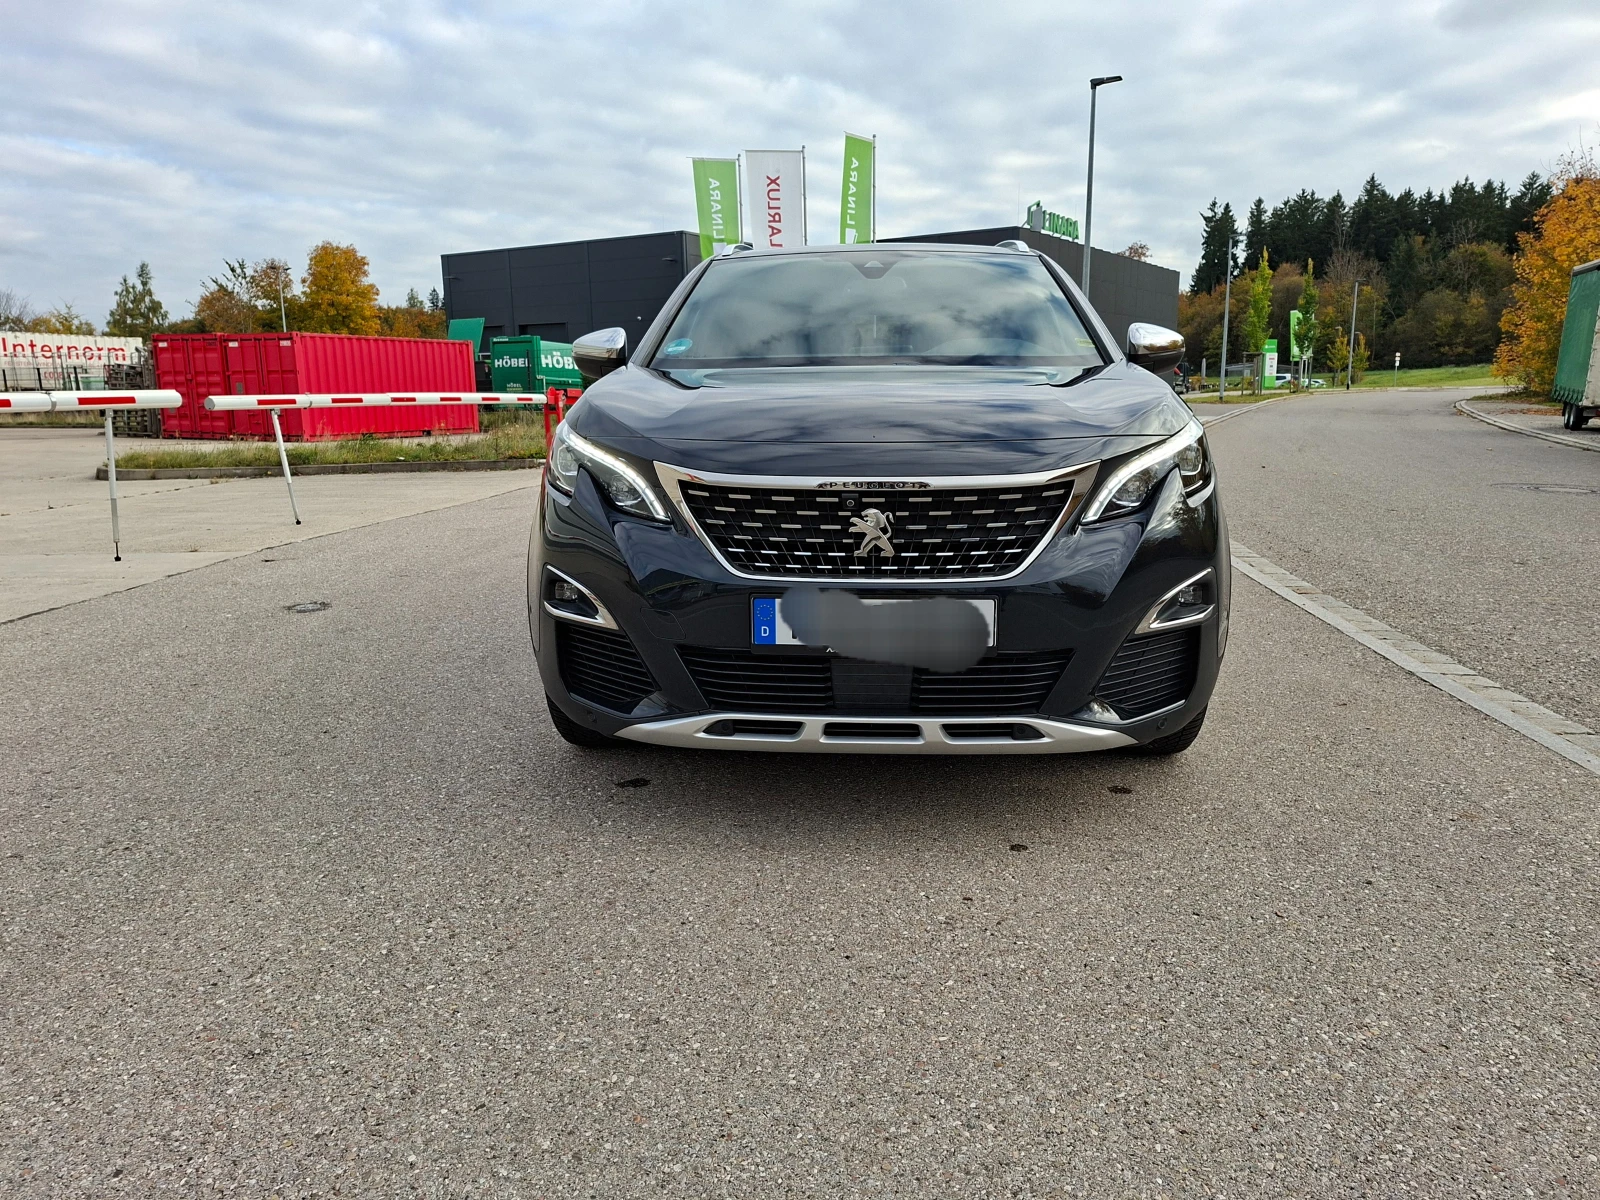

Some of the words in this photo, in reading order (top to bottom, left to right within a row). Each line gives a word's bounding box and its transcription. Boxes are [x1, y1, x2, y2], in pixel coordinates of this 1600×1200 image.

[1042, 210, 1079, 240] LINARA
[1, 337, 126, 361] Internorm
[494, 356, 531, 368] HÖBEL
[760, 626, 770, 637] D
